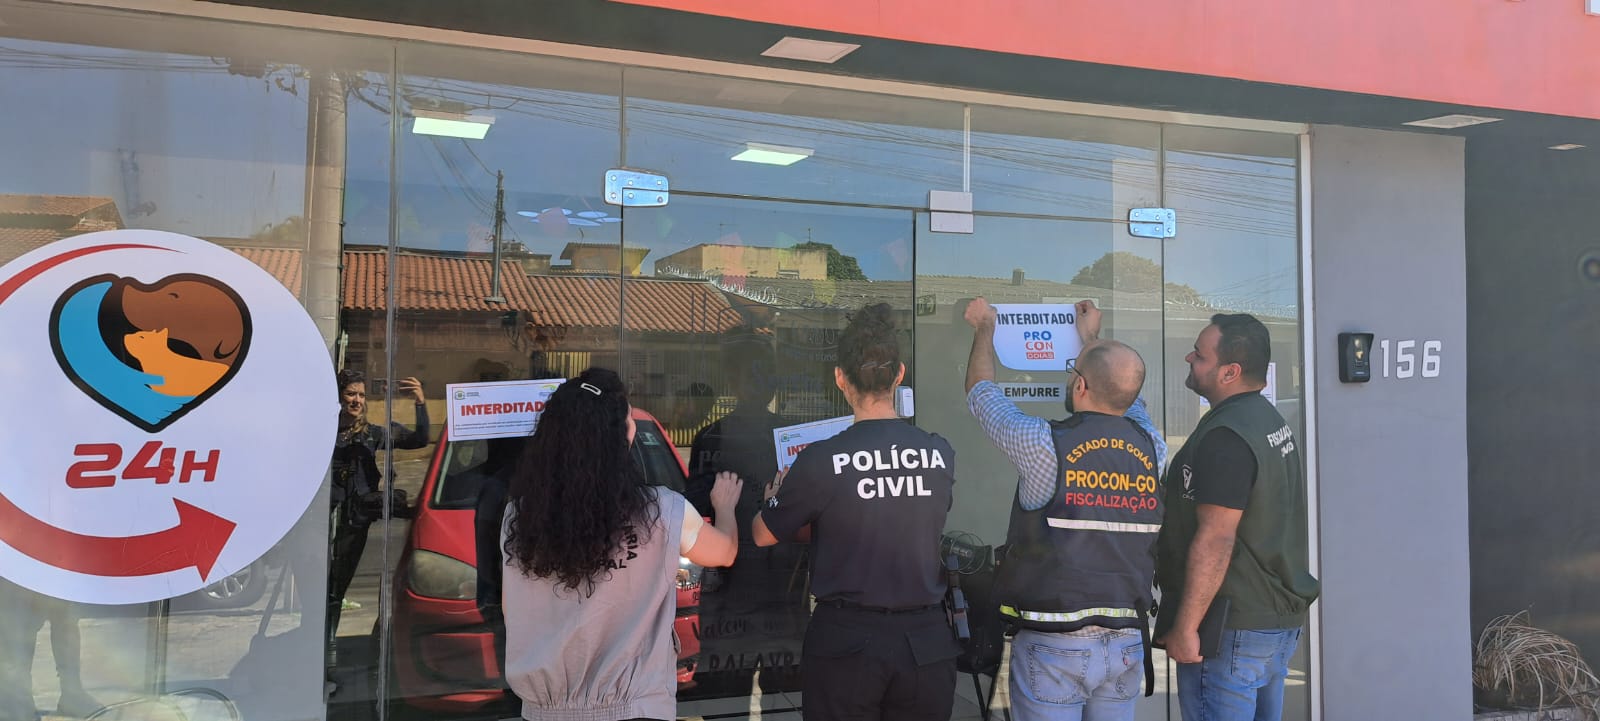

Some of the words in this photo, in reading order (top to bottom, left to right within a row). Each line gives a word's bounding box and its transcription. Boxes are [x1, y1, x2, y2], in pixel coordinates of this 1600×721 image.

[998, 313, 1075, 325] INTERDITADO
[1023, 331, 1052, 340] PRO
[1025, 341, 1053, 351] CON
[1380, 340, 1441, 379] 156
[1004, 387, 1060, 398] EMPURRE
[461, 401, 547, 417] INTERDITAD
[832, 444, 946, 475] POLÍCIA
[1066, 437, 1109, 464] ESTADO
[1111, 438, 1125, 450] DE
[65, 440, 220, 489] 24H
[857, 476, 932, 499] CIVIL
[1065, 470, 1156, 494] PROCON-GO
[1065, 492, 1157, 514] FISCALIZAÇÃO
